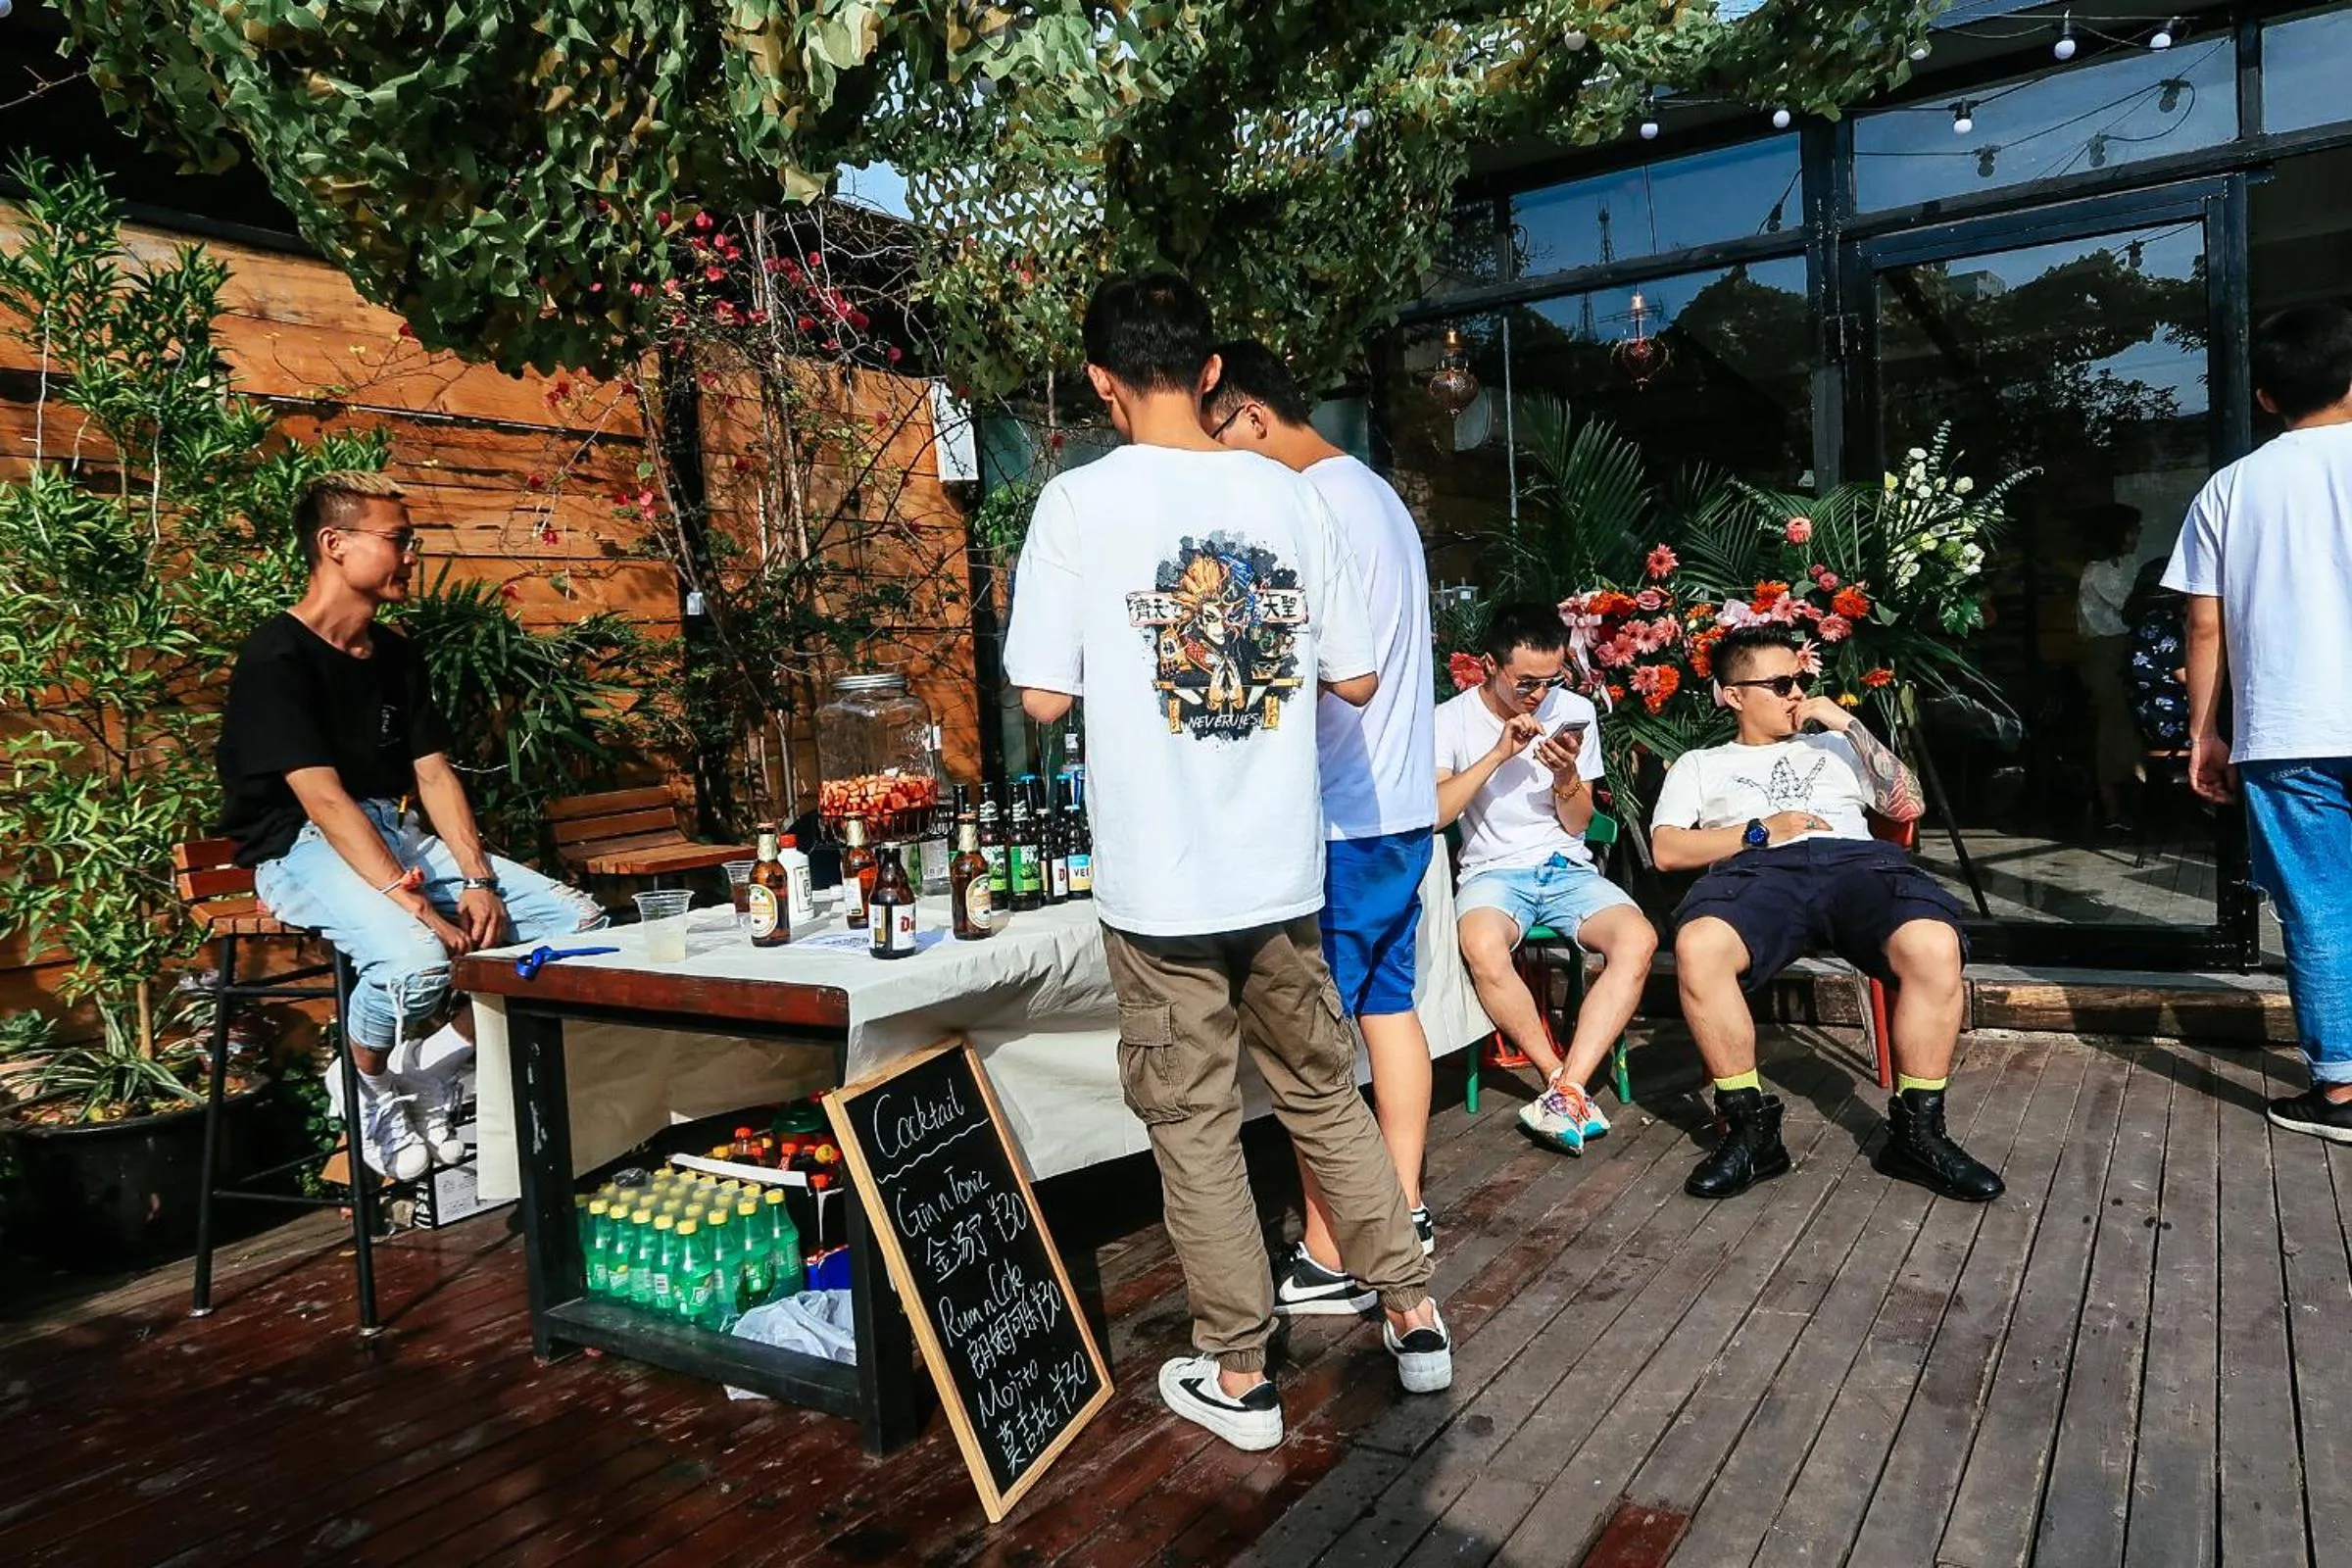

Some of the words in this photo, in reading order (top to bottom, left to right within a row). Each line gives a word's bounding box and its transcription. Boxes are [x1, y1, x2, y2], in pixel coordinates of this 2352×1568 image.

[873, 1077, 965, 1158] Cocktail
[938, 1192, 955, 1214] n
[943, 1165, 992, 1205] Tonic
[896, 1187, 942, 1238] Gin
[985, 1192, 1028, 1243] ¥30
[938, 1296, 985, 1348] Rum
[983, 1298, 998, 1317] n
[976, 1358, 1040, 1429] Mojito
[996, 1395, 1058, 1477] 莫吉托
[1048, 1349, 1088, 1415] ¥30
